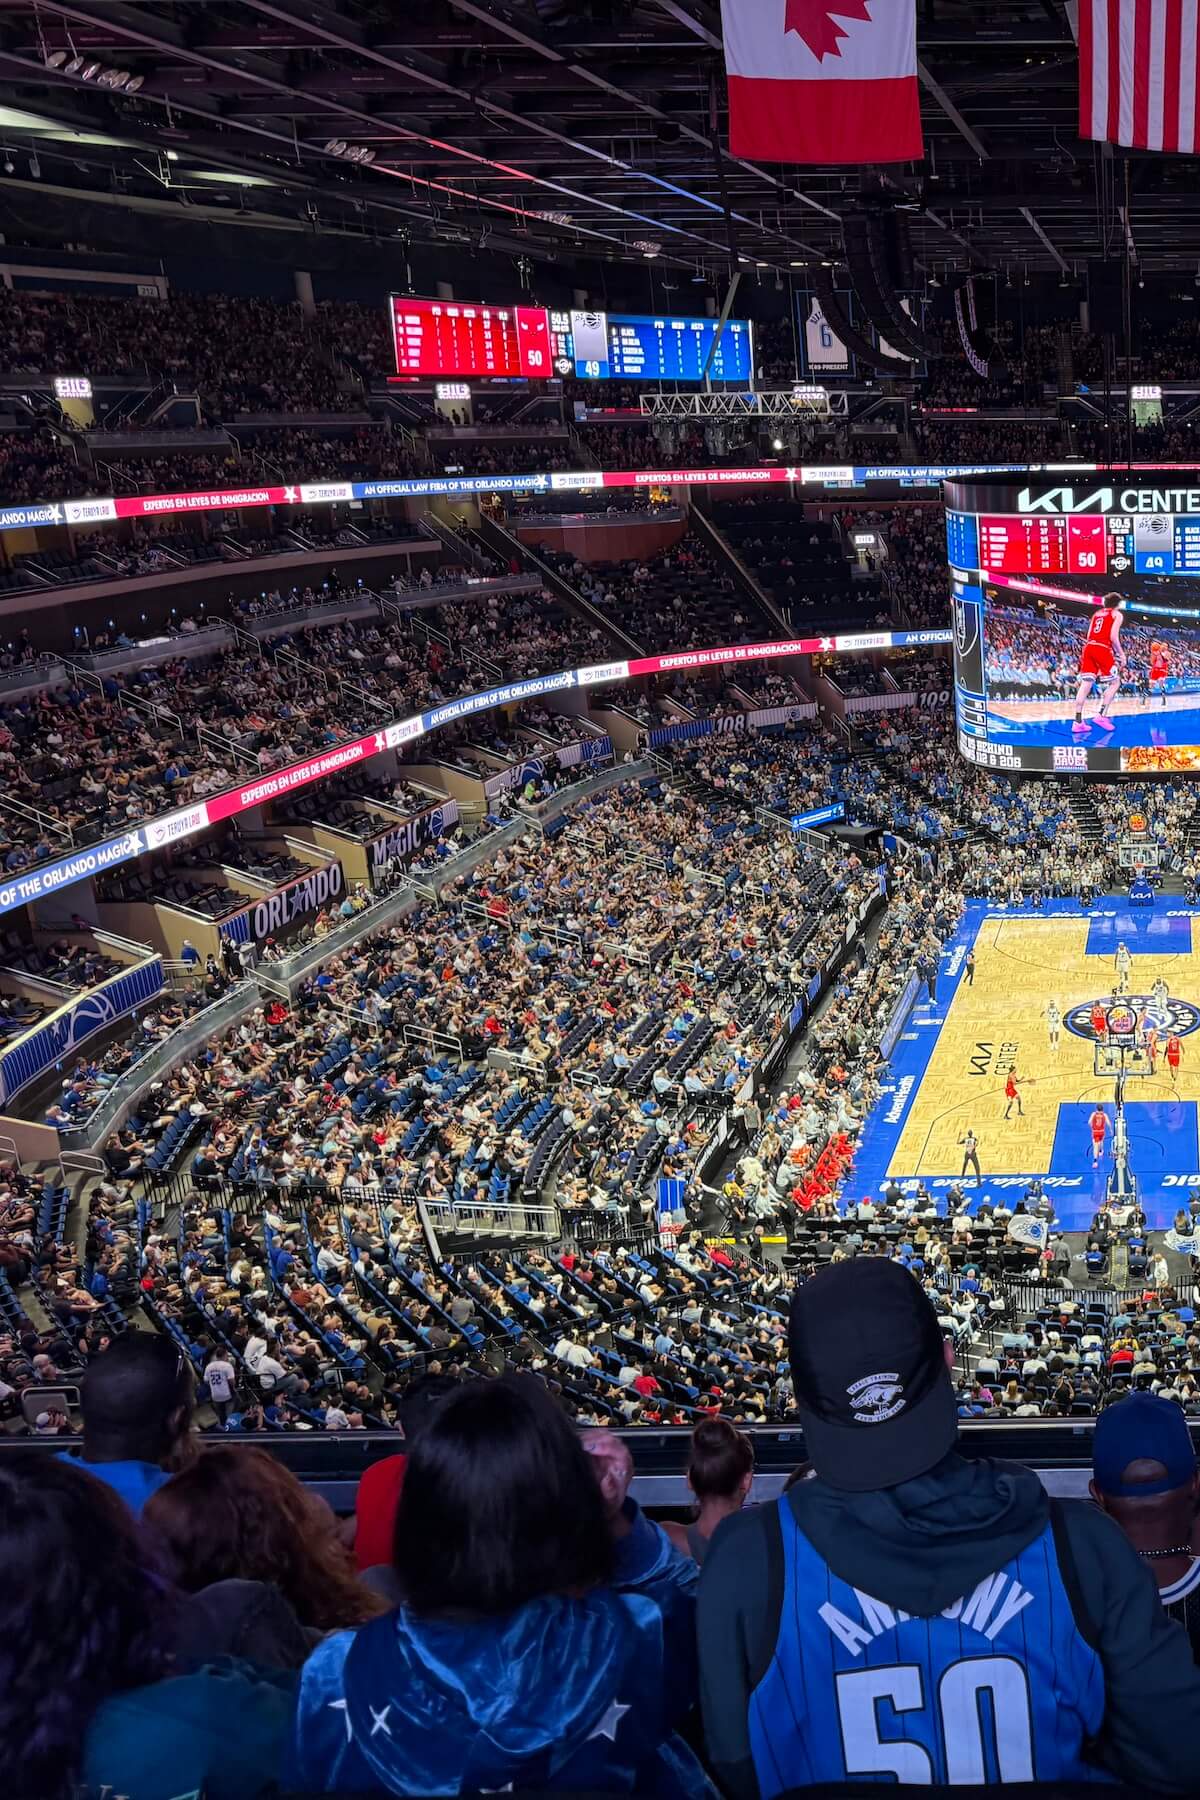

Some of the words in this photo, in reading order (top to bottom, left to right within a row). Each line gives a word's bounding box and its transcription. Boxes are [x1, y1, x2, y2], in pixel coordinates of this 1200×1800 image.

[551, 312, 569, 325] 50.5
[527, 350, 543, 366] 50
[584, 360, 600, 376] 49
[56, 377, 92, 391] BIG
[436, 383, 471, 395] BIG
[364, 485, 376, 495] AN
[376, 484, 411, 494] OFFICIAL
[411, 482, 429, 493] LAW
[429, 482, 448, 491] FIRM
[447, 481, 459, 490] OF
[459, 480, 475, 490] THE
[474, 479, 513, 489] ORLANDO
[1017, 487, 1113, 513] KIA
[0, 512, 26, 525] ANDO
[1109, 517, 1131, 529] 50.5
[1077, 552, 1097, 567] 50
[659, 654, 698, 668] EXPERTOS
[698, 653, 710, 663] EN
[710, 650, 734, 661] LEYES
[734, 648, 747, 658] DE
[747, 643, 802, 657] INMIGRACION
[919, 691, 950, 707] 109
[716, 713, 745, 734] 108
[976, 739, 1014, 755] BEHIND
[1053, 746, 1087, 757] BIG
[0, 887, 17, 906] OF
[17, 877, 42, 898] THE
[42, 855, 96, 888] ORLANDO
[97, 842, 132, 865] MAGIC
[817, 1571, 1035, 1657] ANNY
[833, 1654, 1036, 1786] 50
